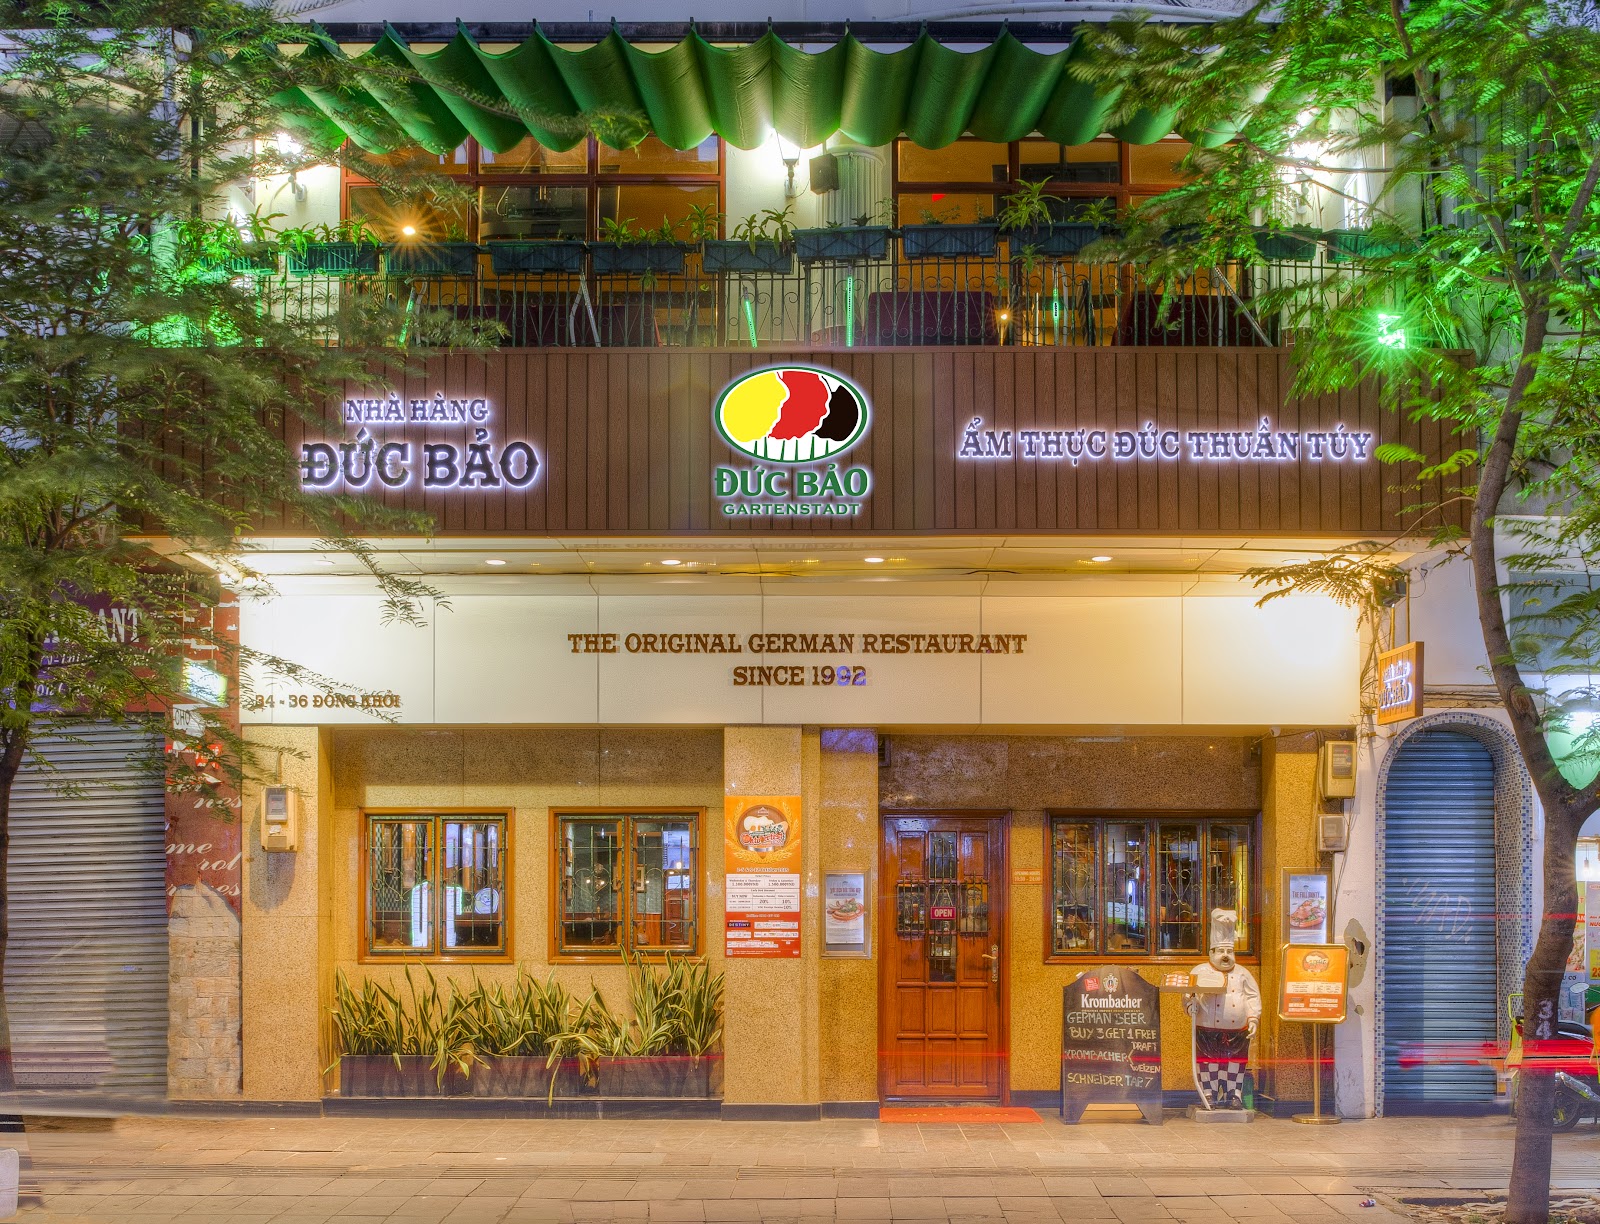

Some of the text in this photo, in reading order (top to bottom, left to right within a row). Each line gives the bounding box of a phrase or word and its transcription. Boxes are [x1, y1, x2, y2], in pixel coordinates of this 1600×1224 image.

[346, 392, 489, 422] NHÀ HÀNG
[959, 416, 1372, 466] ẨM THỰC ĐỨC THUẦN TÚY
[300, 427, 540, 487] ĐỨC BẢO
[714, 463, 868, 497] ĐỨC BẢO
[722, 503, 860, 515] GARTENSTADT
[567, 633, 1028, 653] THE ORIGINAL GERMAN RESTAURANT
[732, 666, 867, 686] SINCE 1992
[288, 694, 308, 708] 36
[934, 908, 953, 918] OPEN
[1081, 993, 1143, 1009] Krombacher
[1066, 1011, 1112, 1025] GERMAN
[1069, 1026, 1094, 1040] BUY
[1096, 1027, 1105, 1039] 3
[1105, 1027, 1127, 1039] GET
[1135, 1028, 1157, 1039] FREE
[1131, 1041, 1157, 1052] DRAFT
